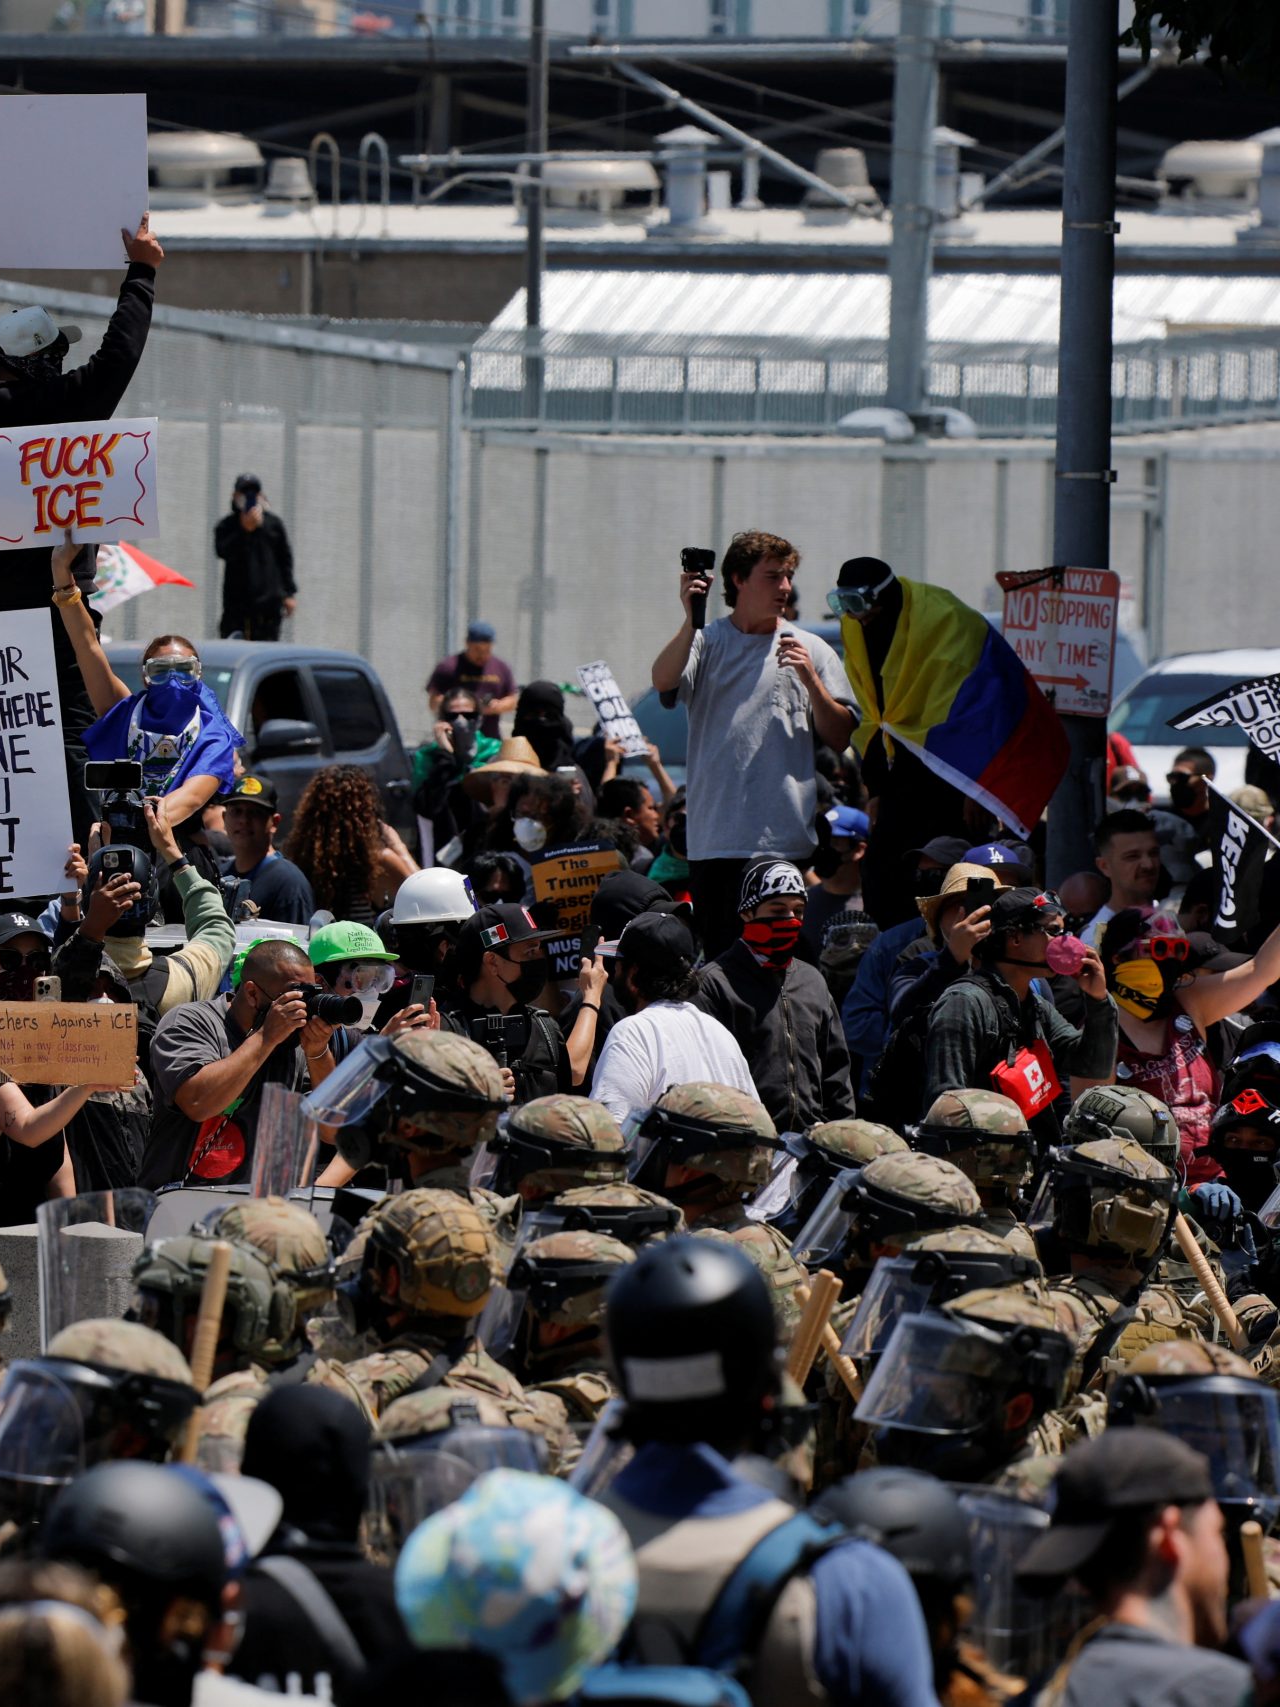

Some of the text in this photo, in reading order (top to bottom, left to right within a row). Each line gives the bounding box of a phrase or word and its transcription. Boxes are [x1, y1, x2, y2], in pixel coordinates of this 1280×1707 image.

[19, 433, 122, 485] FUCK
[32, 481, 104, 534] ICE
[1065, 573, 1103, 592] WAY
[1006, 592, 1111, 629] NO STOPPING
[1015, 638, 1098, 667] ANY TIME
[988, 847, 1004, 863] LA
[558, 859, 589, 871] The
[11, 914, 29, 927] LA
[547, 938, 581, 955] MUS
[51, 1012, 101, 1039] Against
[111, 1013, 133, 1030] ICE
[0, 1038, 15, 1051] Not
[23, 1042, 31, 1050] in
[36, 1041, 51, 1055] my
[0, 1054, 15, 1065] Not
[37, 1055, 50, 1066] my
